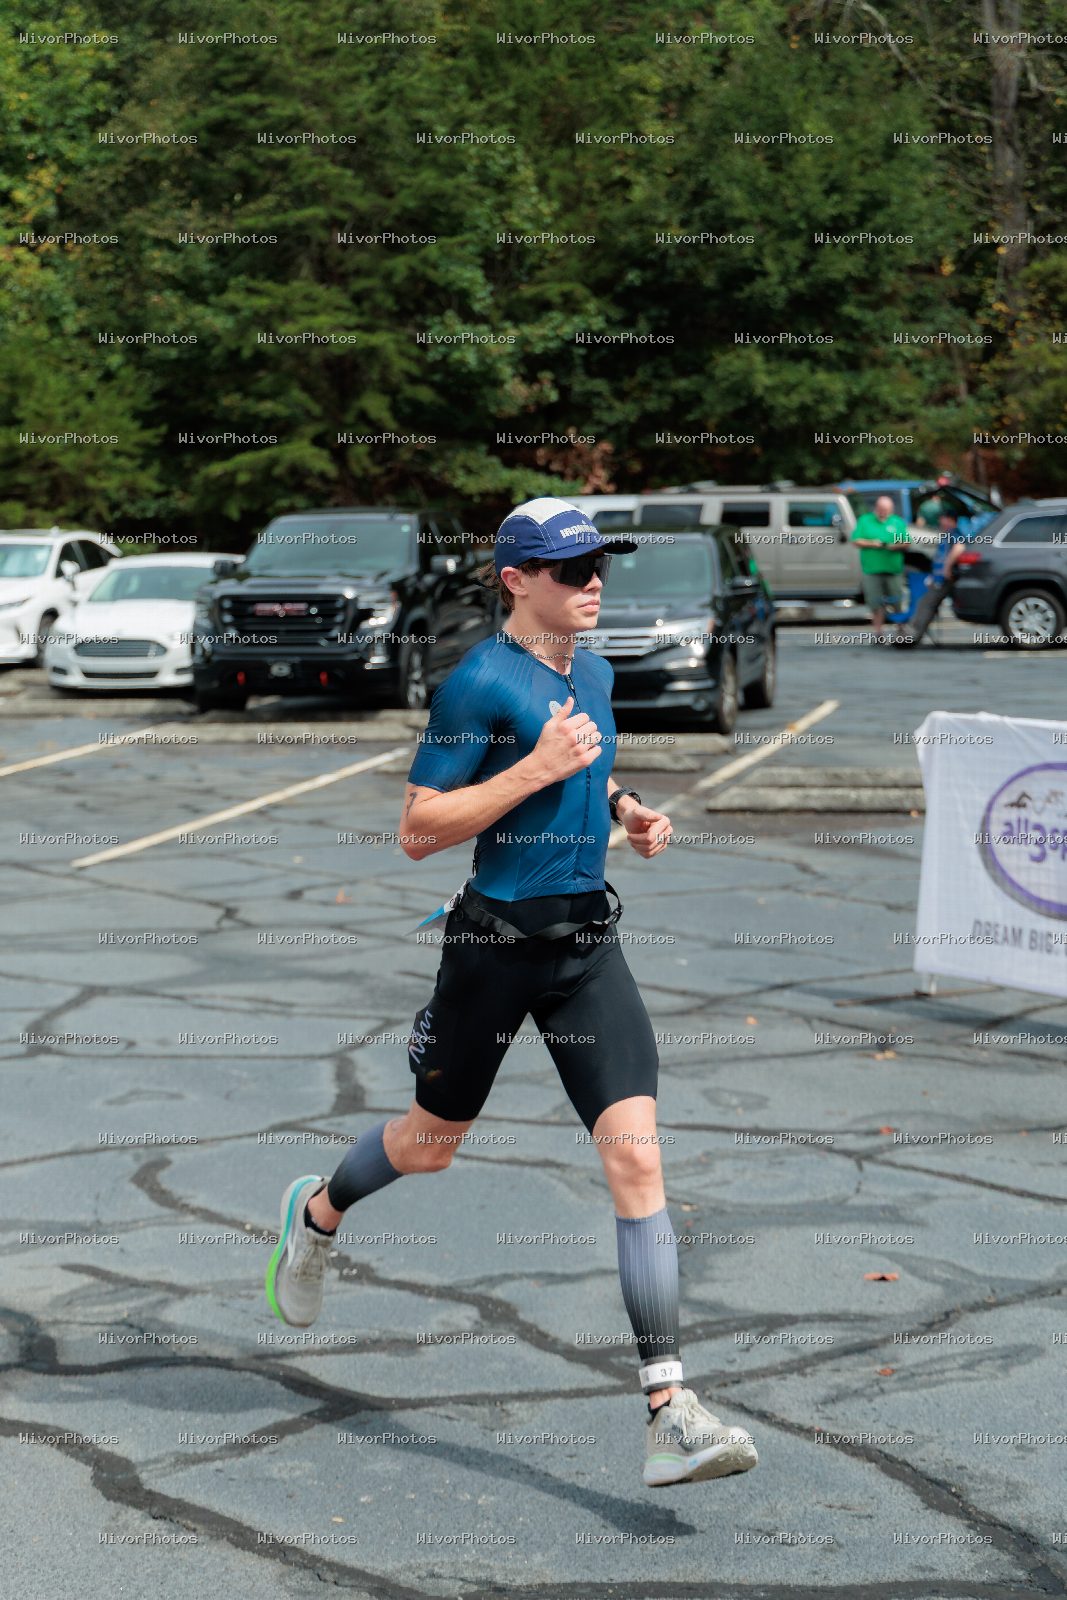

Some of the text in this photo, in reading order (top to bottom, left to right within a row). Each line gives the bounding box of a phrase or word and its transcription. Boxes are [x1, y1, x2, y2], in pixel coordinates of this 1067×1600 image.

[560, 524, 600, 538] IRONM
[972, 919, 1023, 949] DREAM
[660, 1368, 673, 1378] 37
